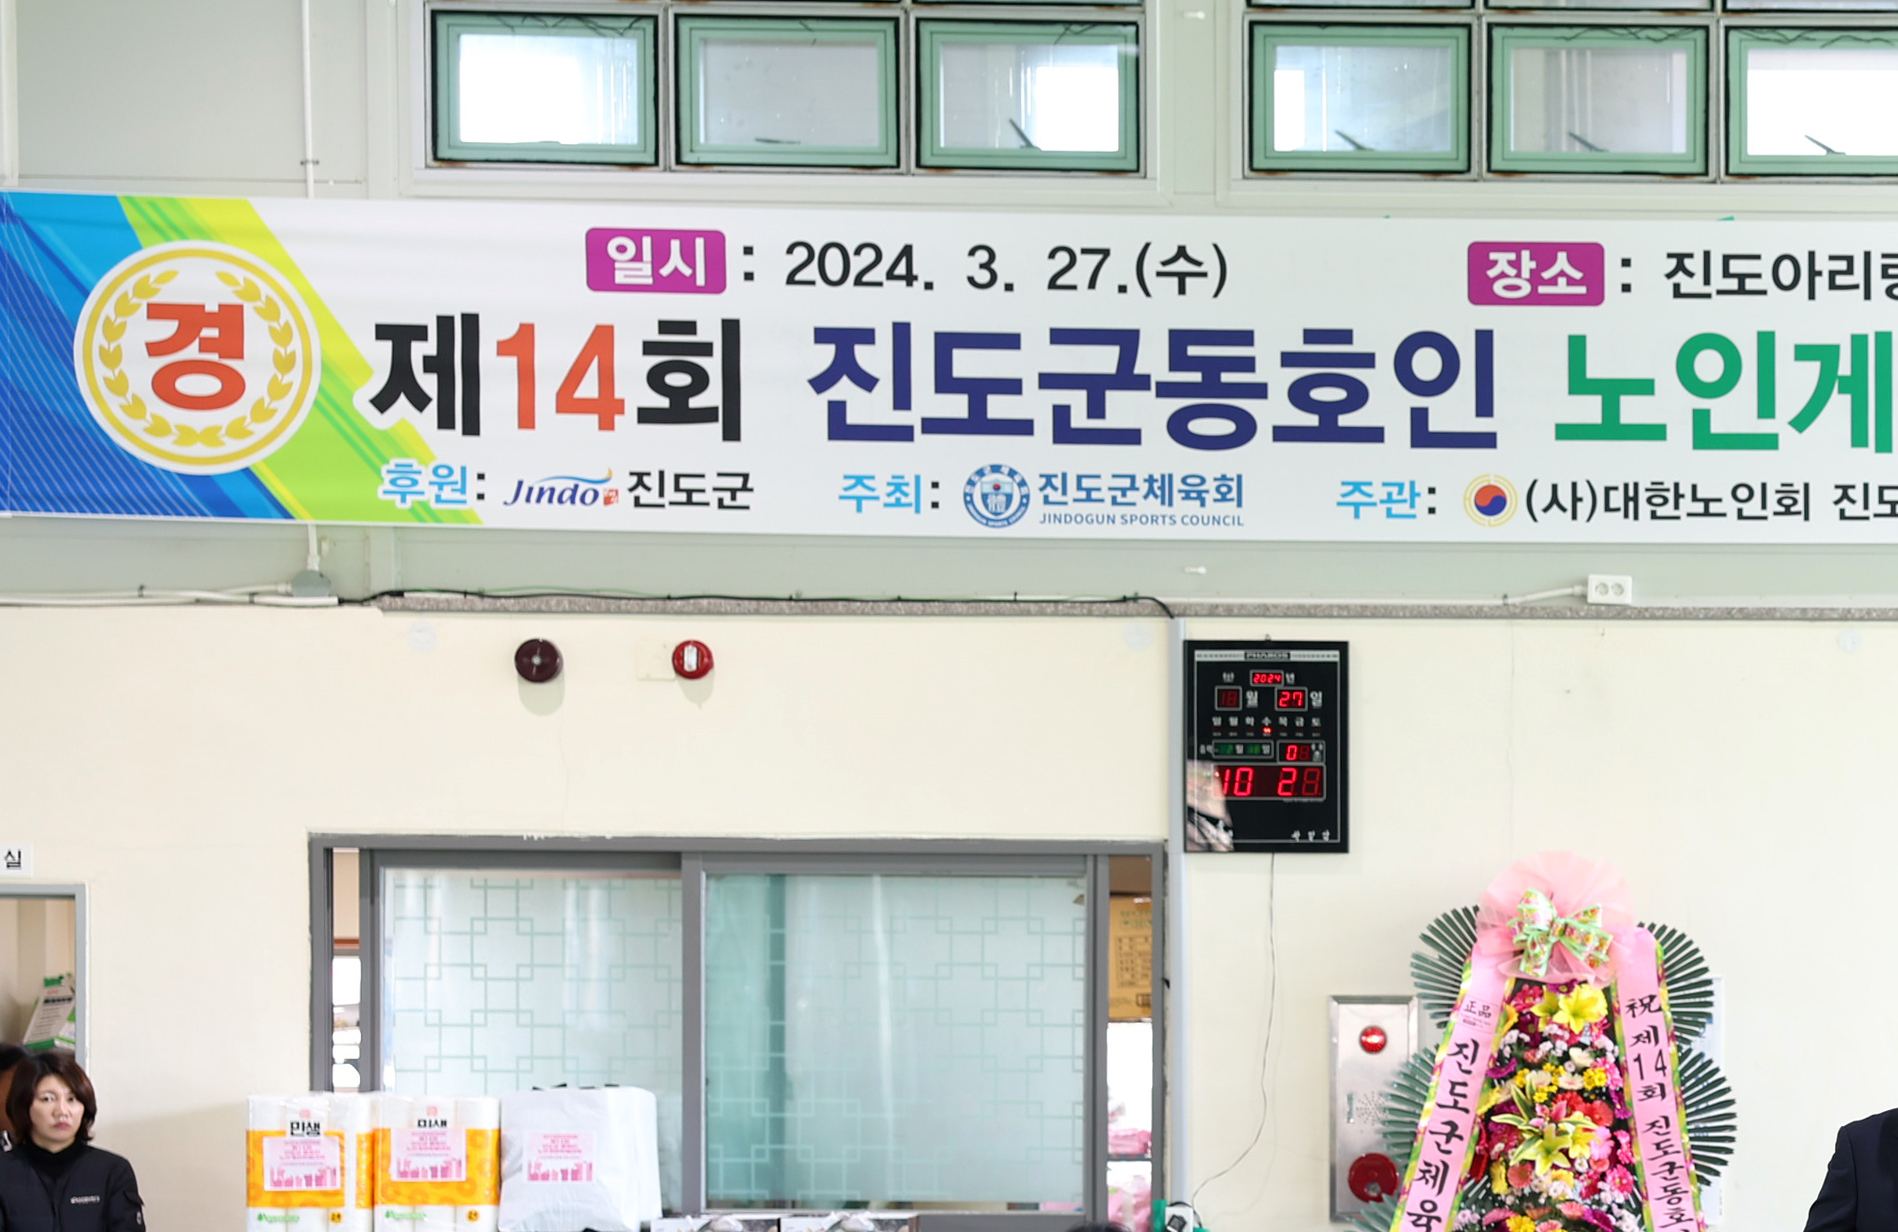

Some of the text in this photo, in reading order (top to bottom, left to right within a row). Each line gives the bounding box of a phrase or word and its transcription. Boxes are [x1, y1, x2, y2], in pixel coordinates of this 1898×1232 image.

[606, 235, 707, 286] 일시
[786, 241, 933, 290] 2024.
[967, 245, 1014, 292] 3.
[1048, 242, 1227, 298] 27.(수)
[1484, 250, 1588, 299] 장소
[146, 302, 246, 411] 경
[369, 314, 742, 442] 제14회
[807, 322, 1497, 451] 진도군동호인
[503, 476, 600, 507] Jindo
[628, 470, 754, 510] 진도군
[1039, 473, 1244, 508] 진도군체육회
[1526, 479, 1809, 522] (사)대한노인회
[1039, 513, 1117, 526] JINDOGUN
[1120, 513, 1176, 526] SPORTS
[1180, 513, 1245, 527] COUNCIL
[1253, 673, 1283, 684] 2024
[1278, 691, 1304, 708] 27
[1625, 994, 1661, 1018] 祝
[1629, 1025, 1667, 1101] 제14회
